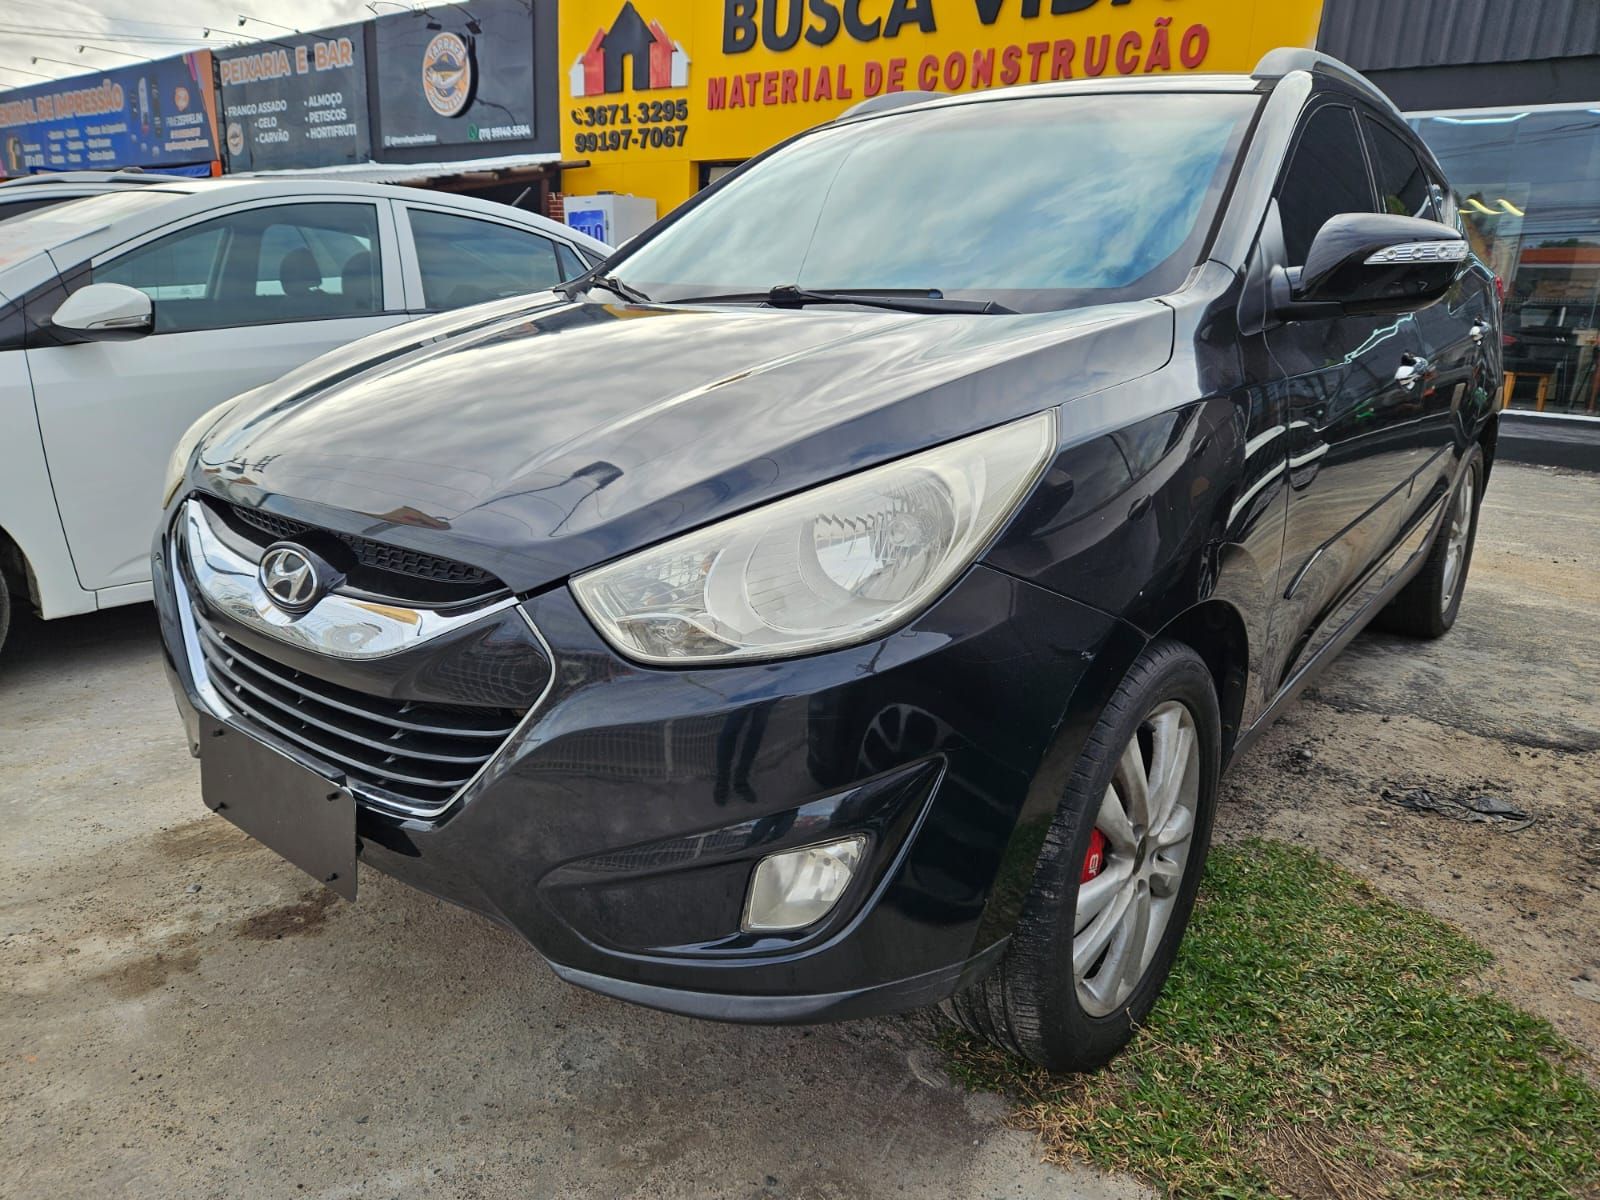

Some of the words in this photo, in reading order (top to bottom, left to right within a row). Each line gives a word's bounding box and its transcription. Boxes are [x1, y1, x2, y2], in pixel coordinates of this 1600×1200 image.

[722, 0, 937, 54] BUSCA
[220, 49, 291, 87] PEIXARIA
[295, 45, 309, 74] E
[314, 37, 353, 71] BAR
[707, 64, 852, 110] MATERIAL
[864, 58, 907, 97] DE
[54, 78, 124, 119] IMPRESSÃO
[308, 92, 342, 109] ALMOÇO
[227, 104, 257, 118] FRANGO
[258, 99, 287, 114] ASSADO
[309, 108, 347, 124] PETISCOS
[258, 116, 278, 129] GELO
[310, 123, 357, 140] HORTIFRUTI
[259, 128, 290, 144] CARVÃO
[575, 125, 688, 153] 99197-7067
